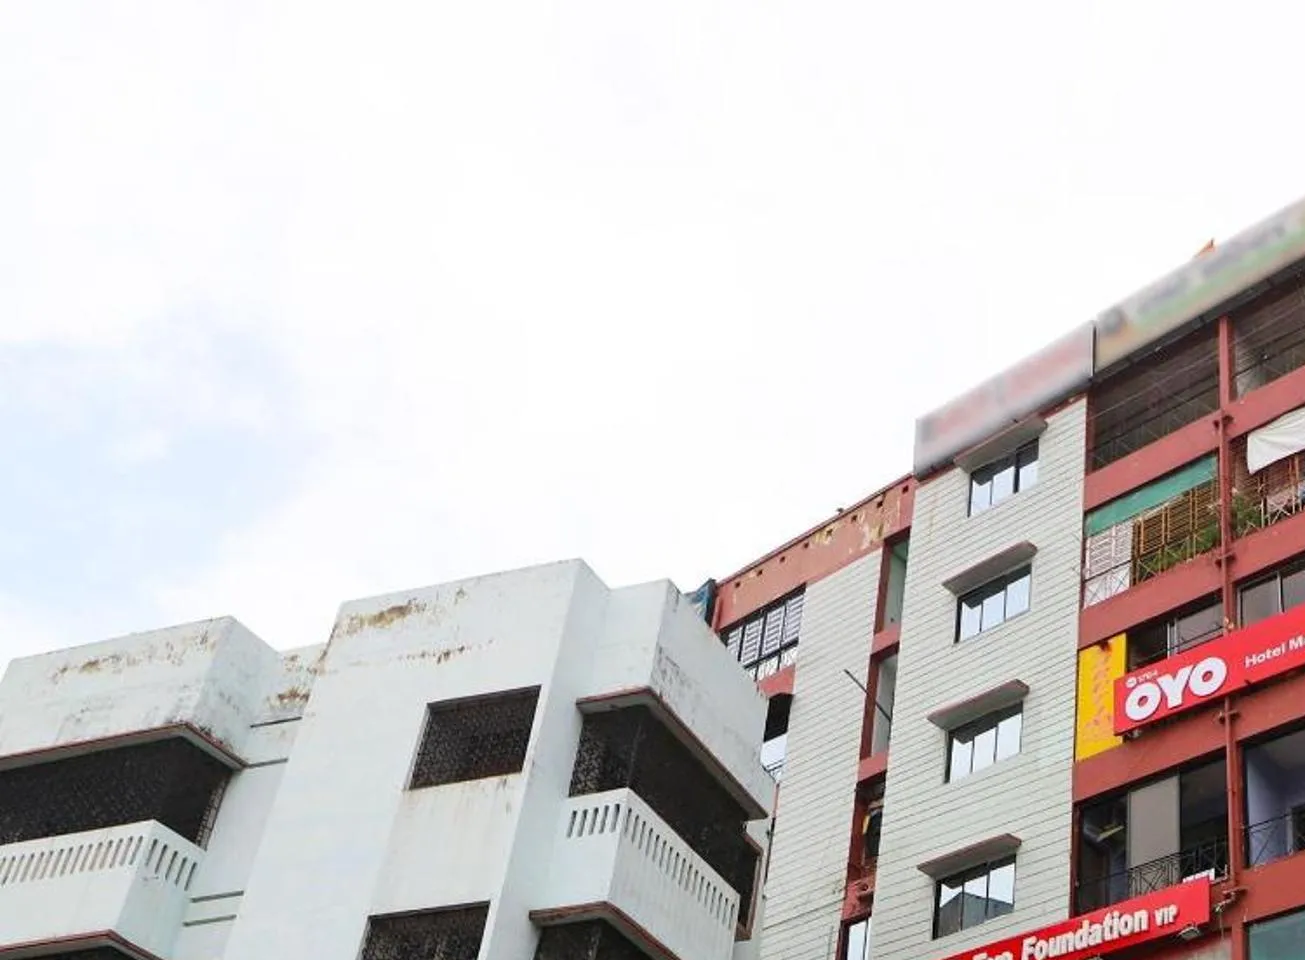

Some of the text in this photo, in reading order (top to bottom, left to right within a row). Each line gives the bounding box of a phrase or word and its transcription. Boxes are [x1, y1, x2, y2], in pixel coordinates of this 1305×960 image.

[1244, 645, 1286, 668] Hotel
[1125, 657, 1227, 720] OYO
[1154, 904, 1179, 926] VIP
